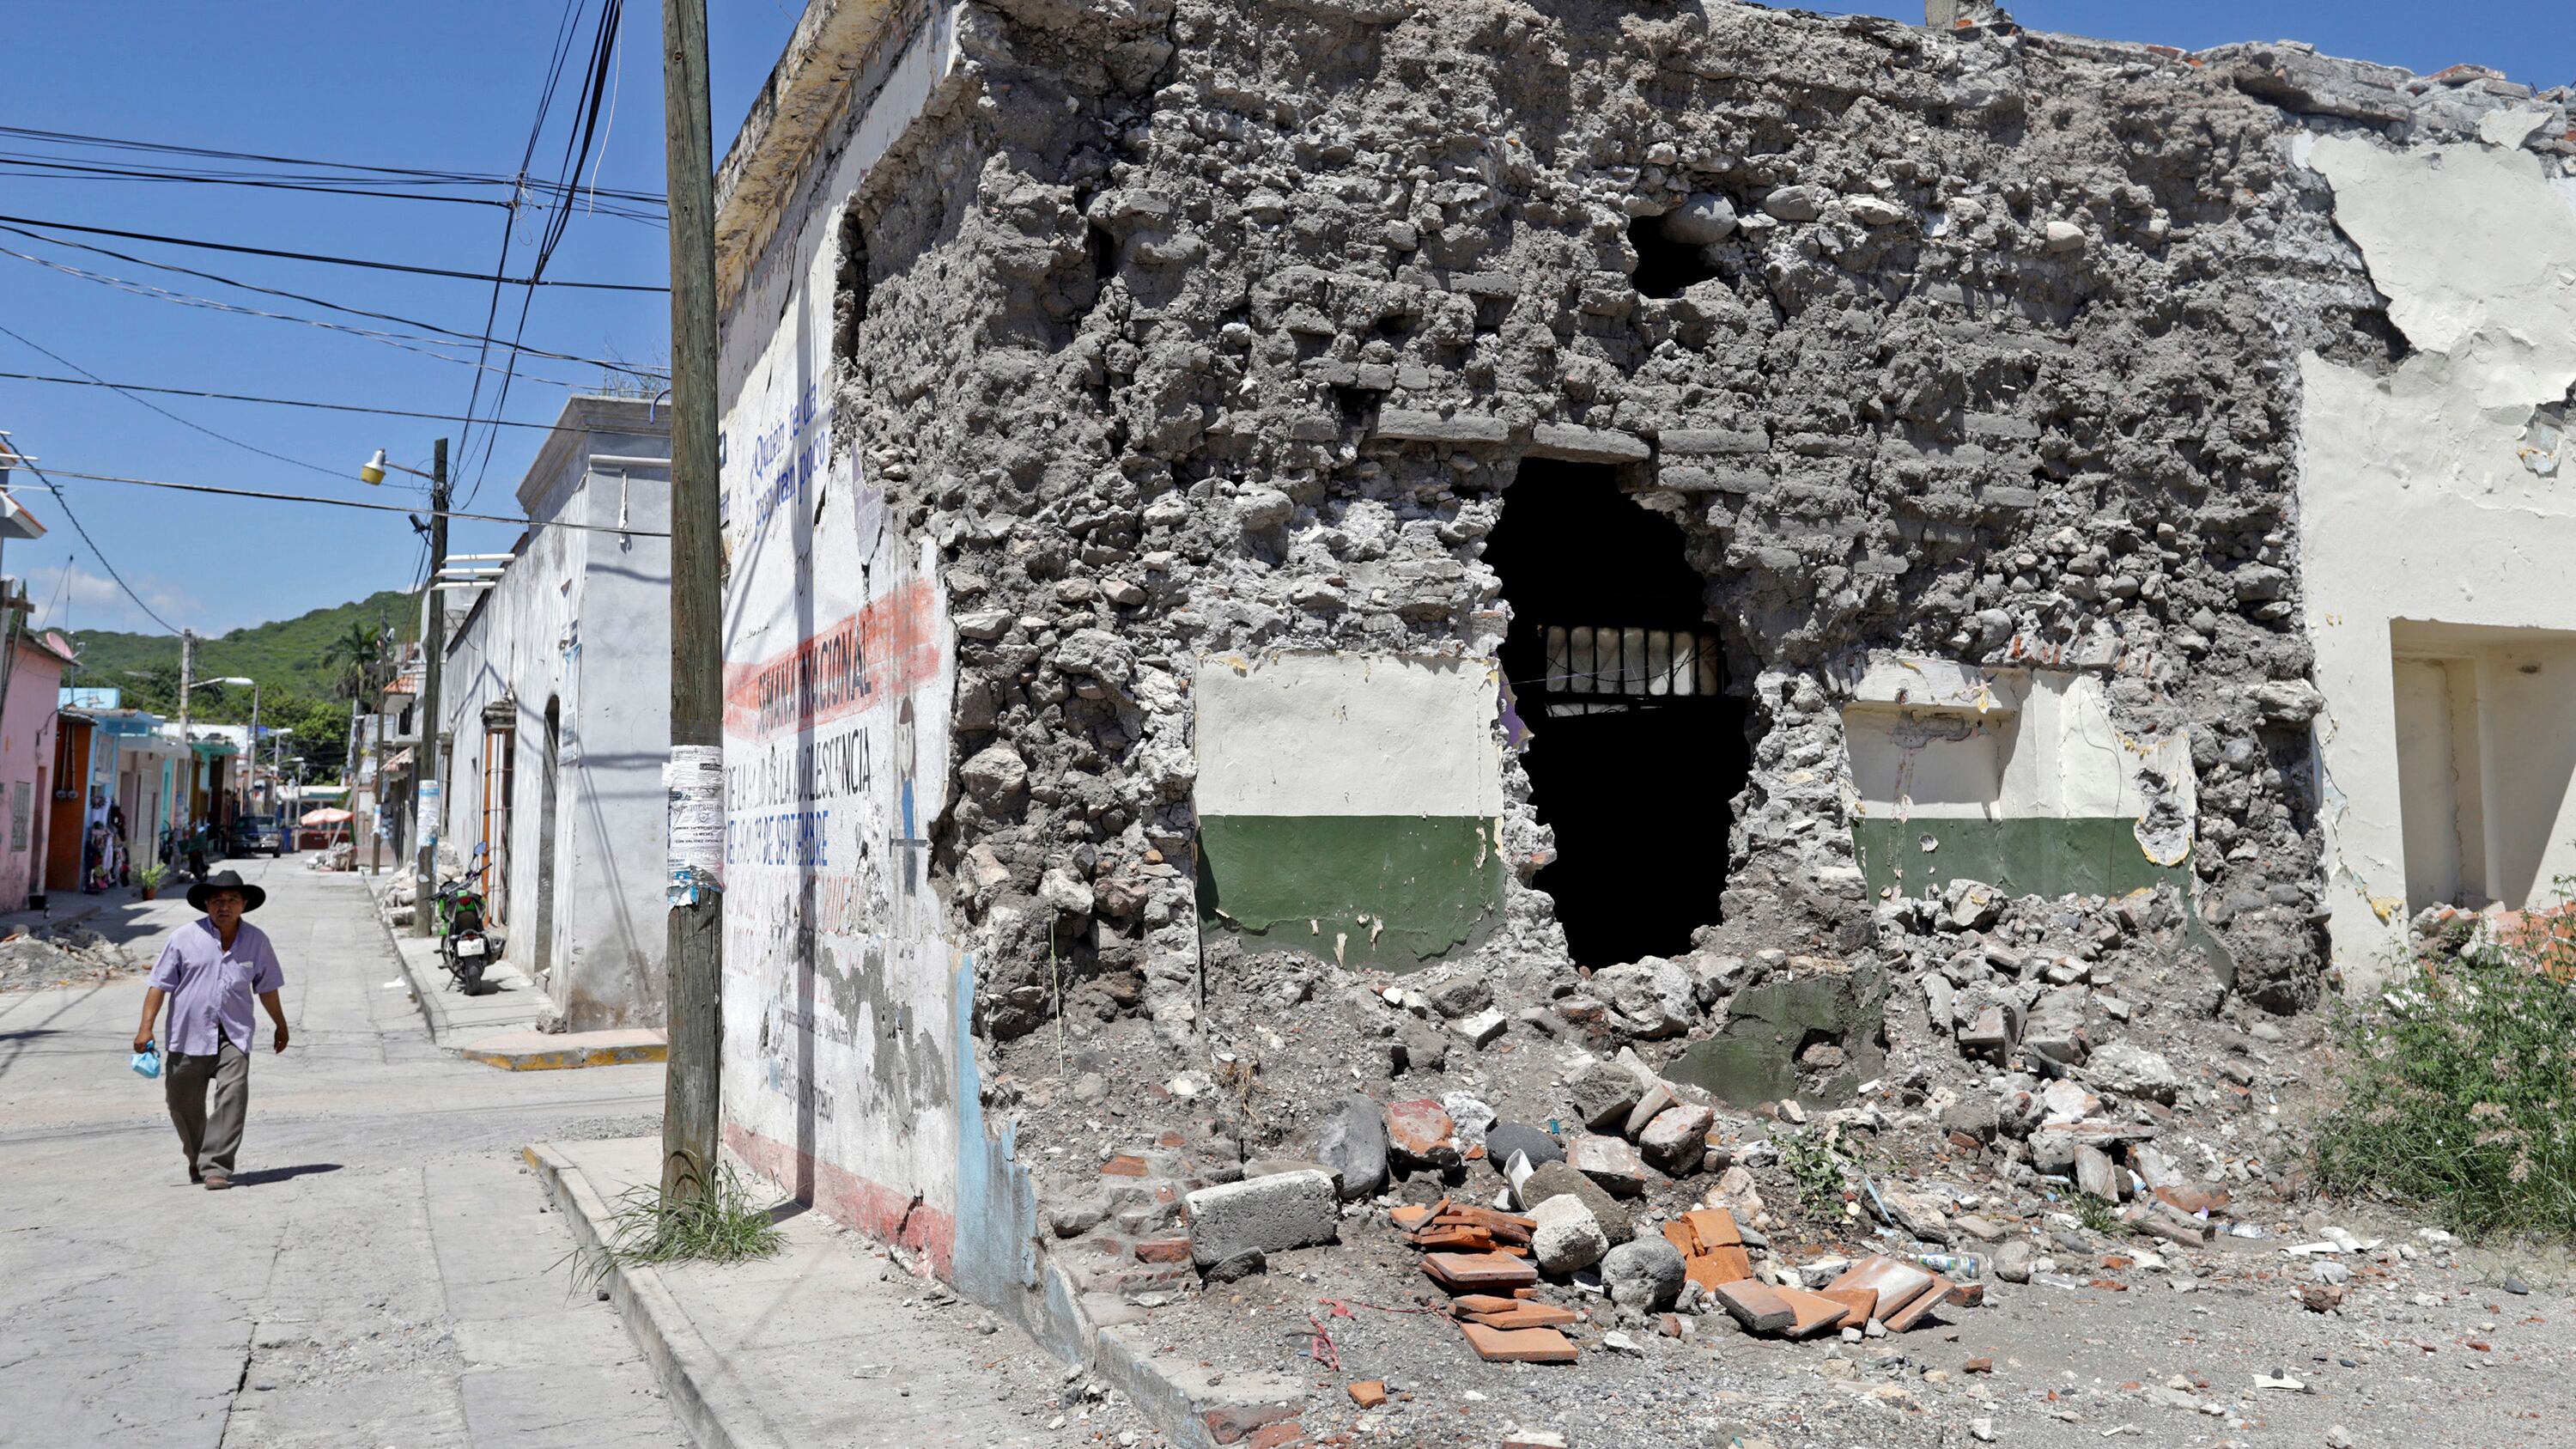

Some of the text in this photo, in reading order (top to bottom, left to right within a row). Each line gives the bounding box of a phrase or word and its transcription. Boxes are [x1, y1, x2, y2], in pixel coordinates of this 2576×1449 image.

[803, 378, 817, 426] da
[755, 484, 773, 542] por
[775, 464, 796, 507] tan
[799, 430, 825, 505] poco
[800, 620, 872, 719] NACIONAL
[781, 752, 791, 805] LA
[793, 727, 871, 804] ADOLESCENCIA
[776, 810, 829, 867] SEPTIEMBRE
